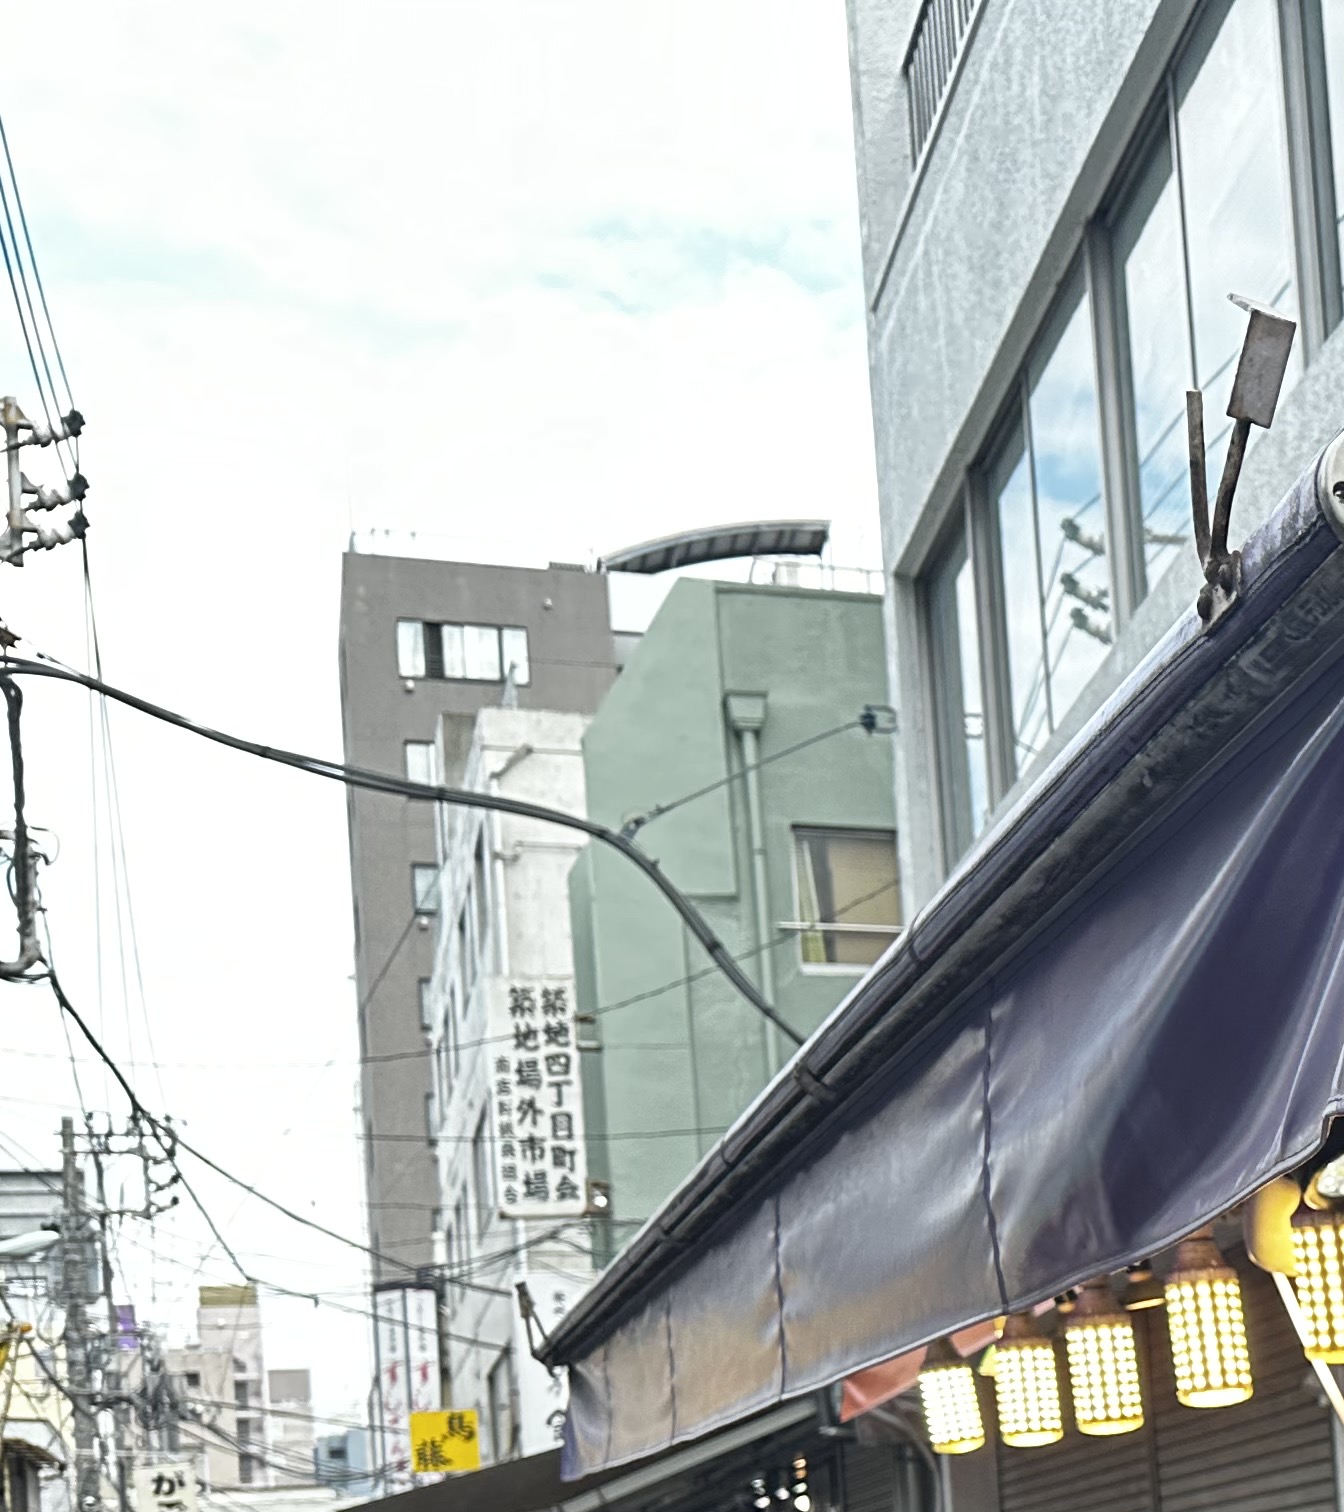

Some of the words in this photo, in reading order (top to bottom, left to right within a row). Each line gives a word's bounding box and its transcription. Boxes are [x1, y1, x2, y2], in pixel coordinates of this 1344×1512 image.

[508, 984, 550, 1202] 築地場外市場
[541, 985, 581, 1201] 築地四丁目町会
